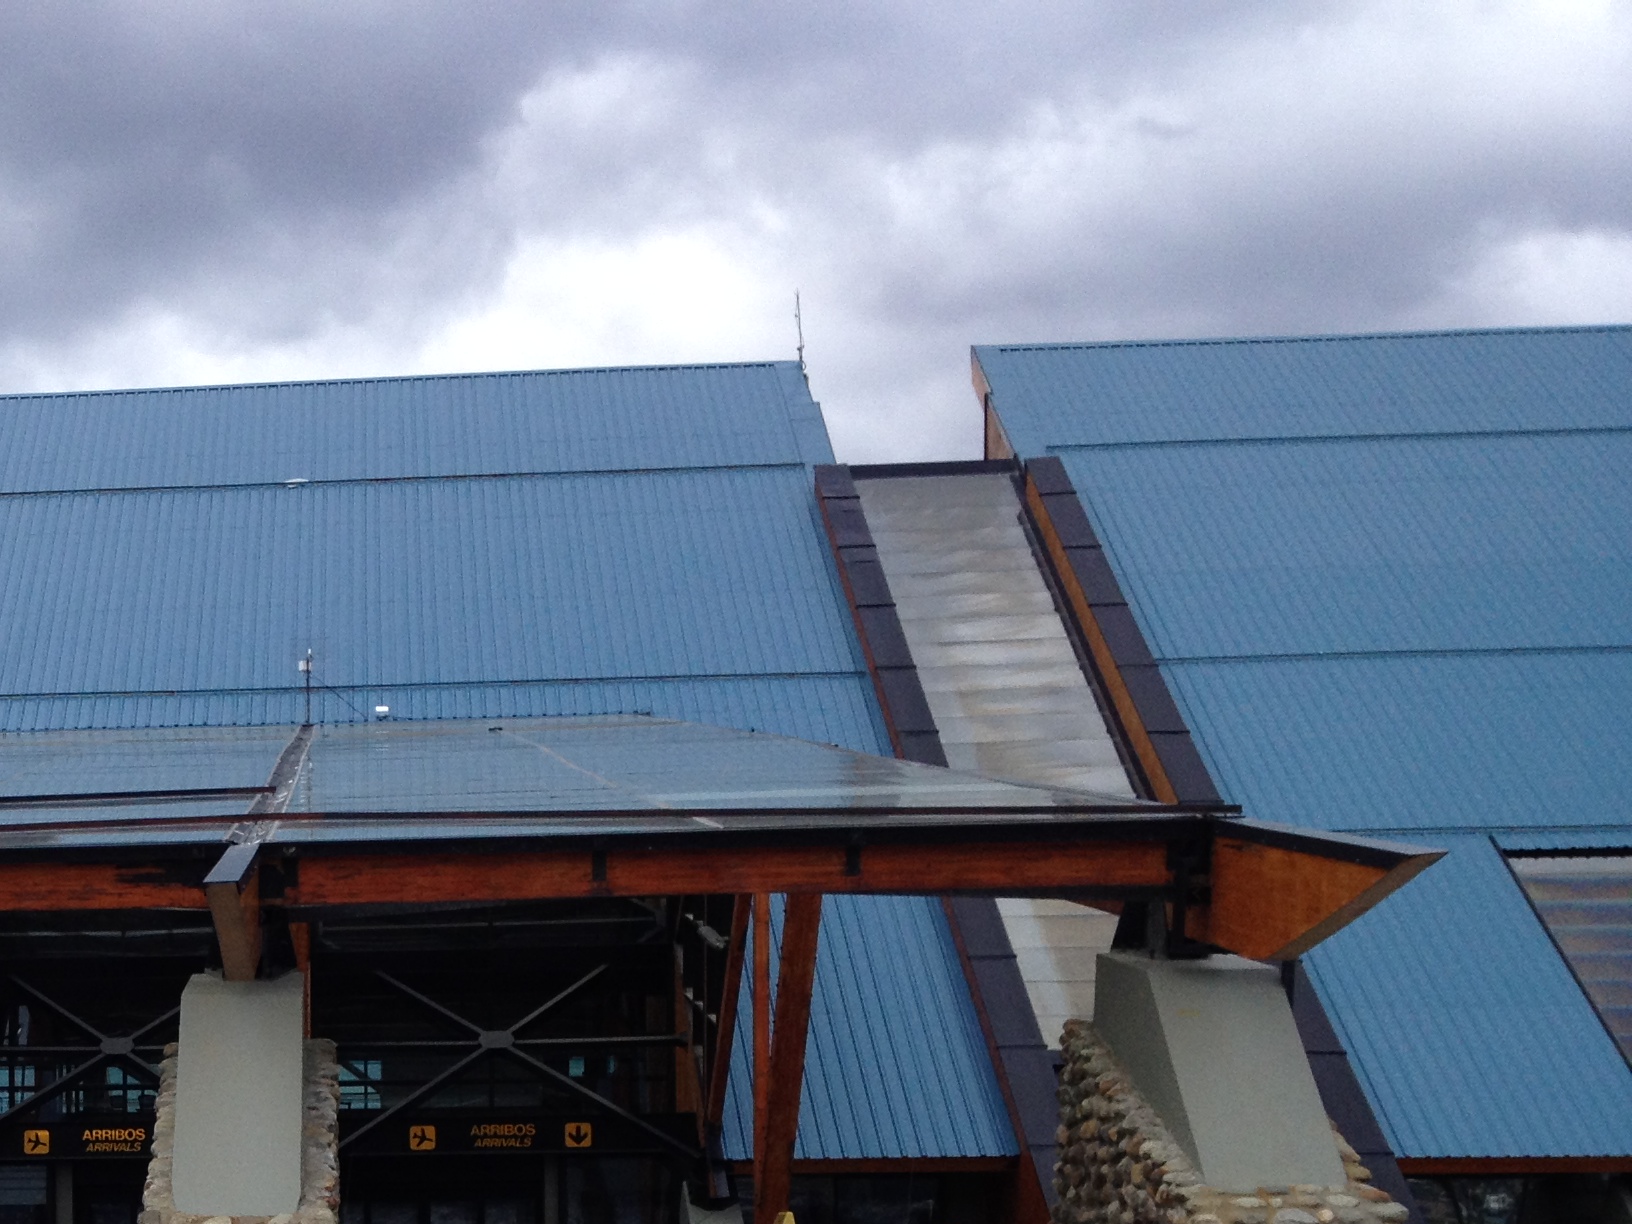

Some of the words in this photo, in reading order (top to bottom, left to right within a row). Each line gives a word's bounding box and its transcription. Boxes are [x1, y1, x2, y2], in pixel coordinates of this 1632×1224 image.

[82, 1128, 146, 1141] ARRIBOS
[470, 1124, 536, 1136] ARRIBOS
[85, 1142, 141, 1152] ARRIVALS
[474, 1138, 532, 1147] ARRIVALS
